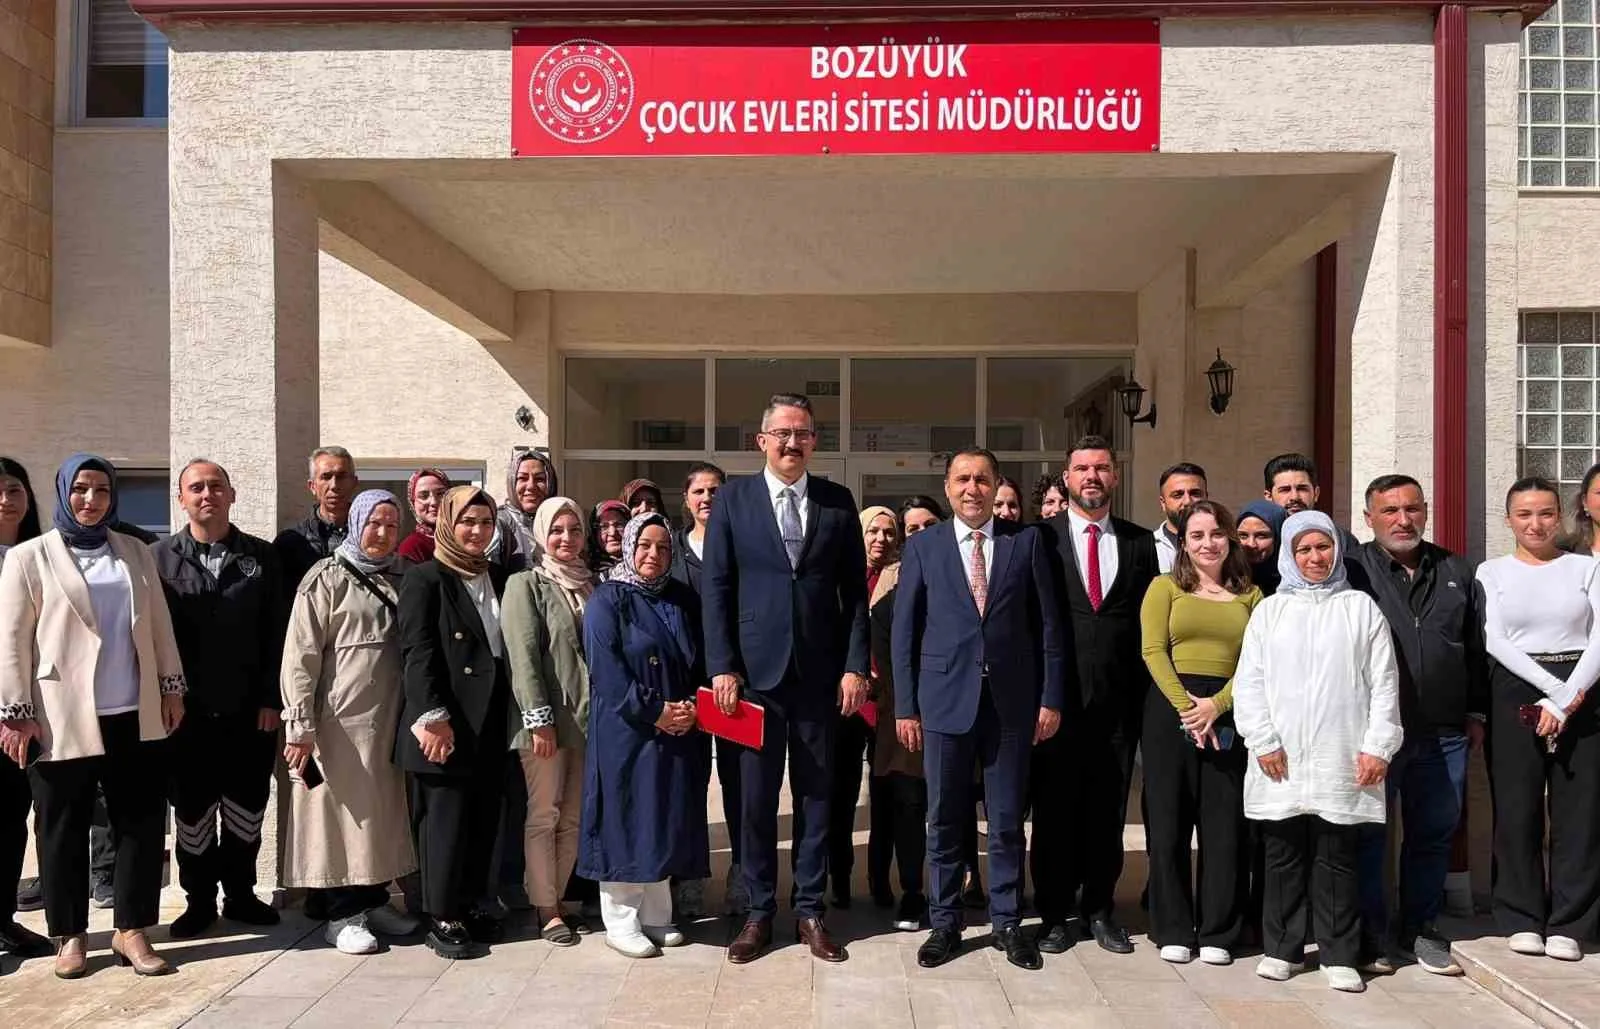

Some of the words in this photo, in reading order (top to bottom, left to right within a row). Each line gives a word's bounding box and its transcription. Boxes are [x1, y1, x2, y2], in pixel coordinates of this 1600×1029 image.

[810, 36, 968, 79] BOZÜYÜK
[639, 100, 737, 143] ÇOCUK
[743, 91, 838, 133] EVLERİ
[844, 90, 929, 132] SİTESİ
[937, 88, 1142, 131] MÜDÜRLÜĞÜ
